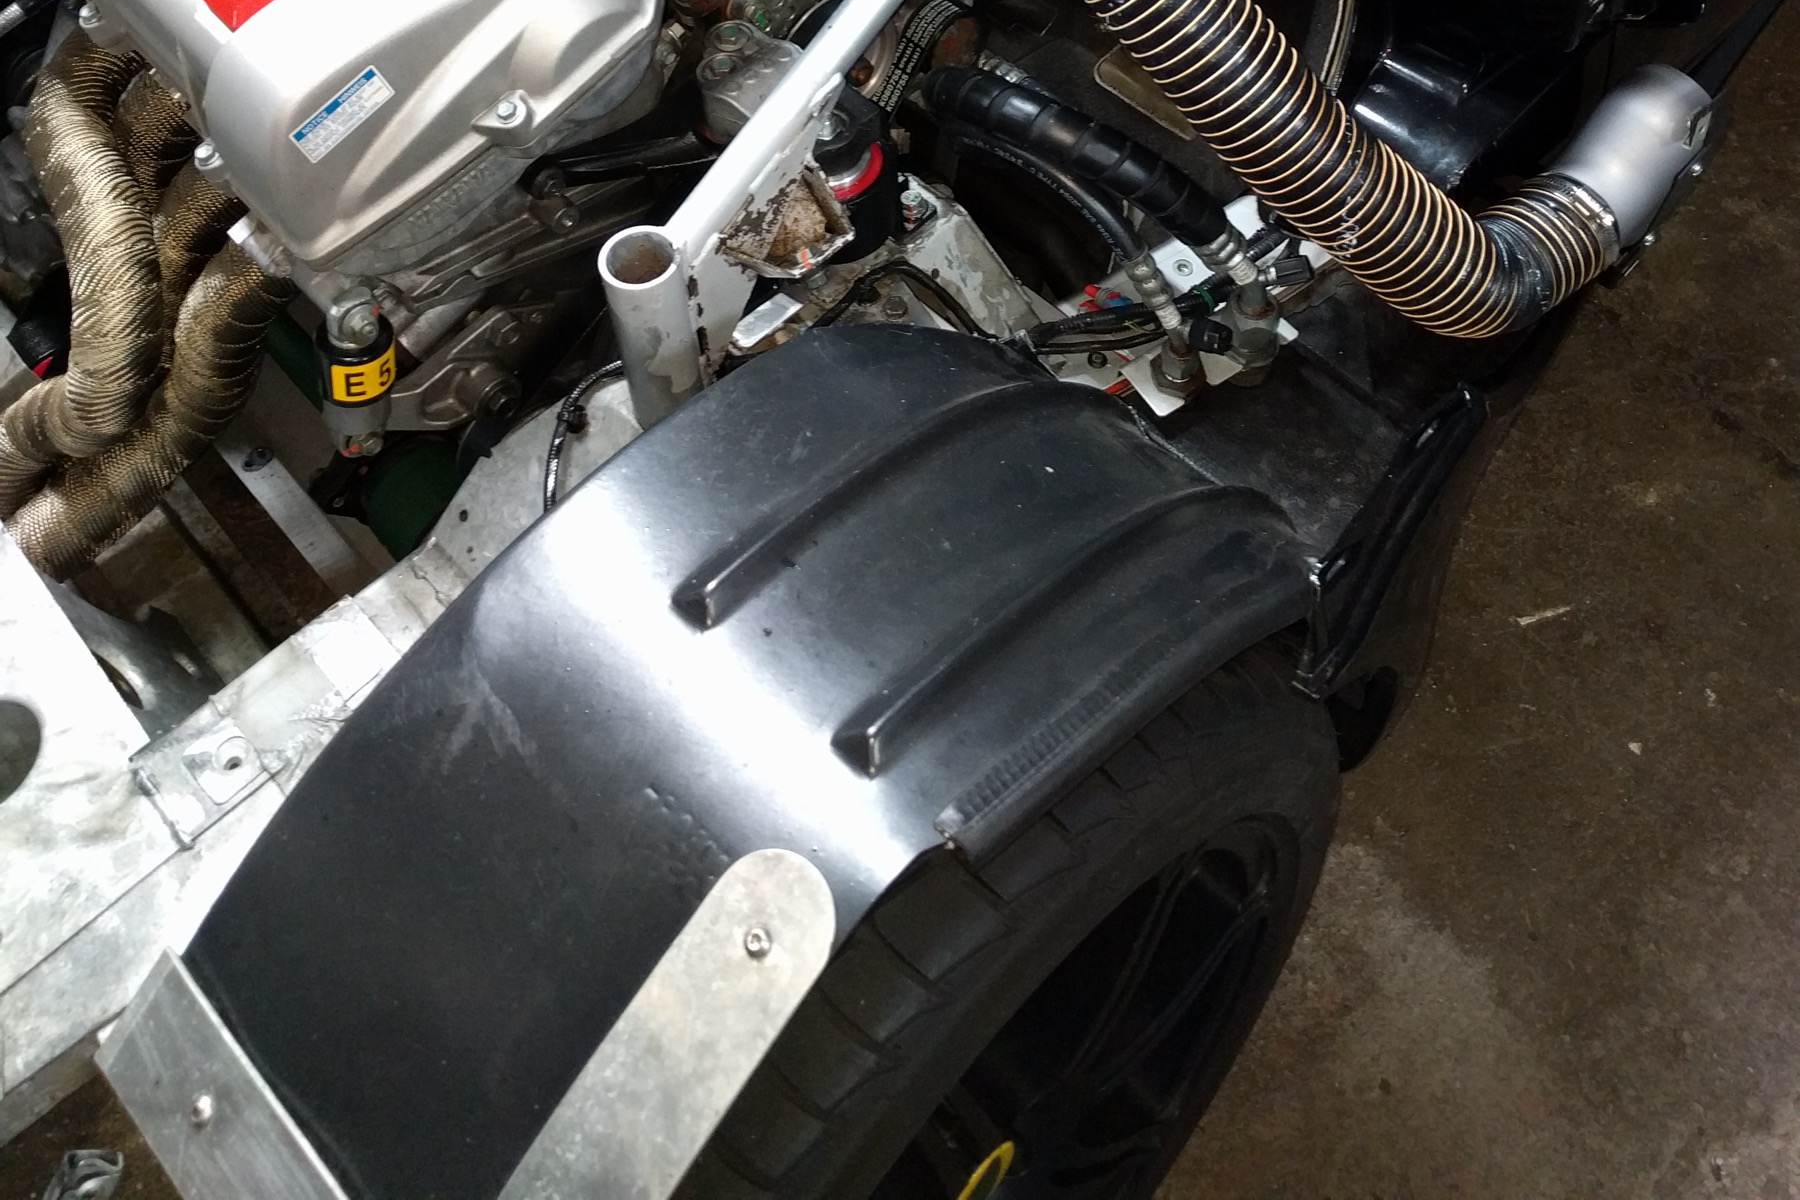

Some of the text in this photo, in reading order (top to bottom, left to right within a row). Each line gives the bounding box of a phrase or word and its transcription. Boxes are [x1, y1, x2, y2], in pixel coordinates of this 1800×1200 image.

[301, 77, 367, 135] NOTICE HINWEIS
[1037, 171, 1058, 189] TYPE
[344, 358, 391, 397] E 5
